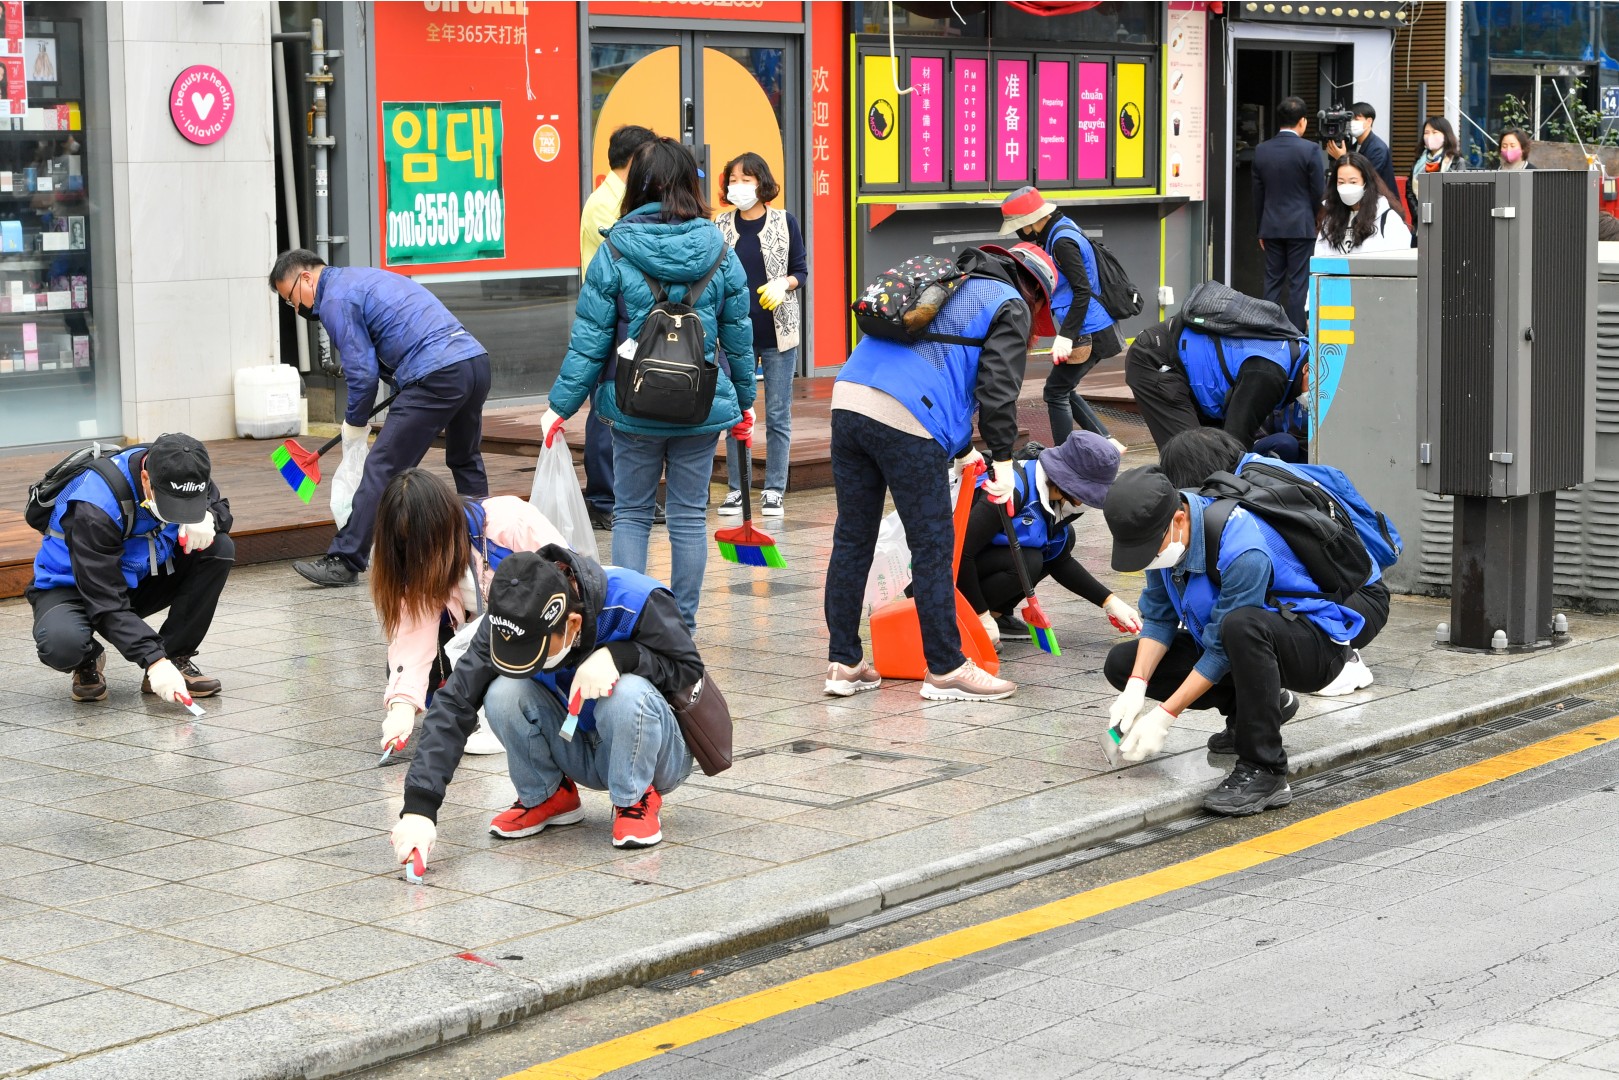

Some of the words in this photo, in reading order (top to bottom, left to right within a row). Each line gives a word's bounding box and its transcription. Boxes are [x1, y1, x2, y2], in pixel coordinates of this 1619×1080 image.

[426, 22, 527, 45] 全年365天打折
[1042, 98, 1064, 107] Preparing
[1604, 96, 1617, 110] 14
[184, 119, 222, 137] lalavla
[922, 66, 931, 173] 材料準備中です
[1004, 73, 1020, 164] 准备中
[1048, 117, 1056, 125] the
[812, 66, 829, 196] 欢迎光临
[392, 106, 495, 183] 임대
[539, 137, 555, 146] TAX
